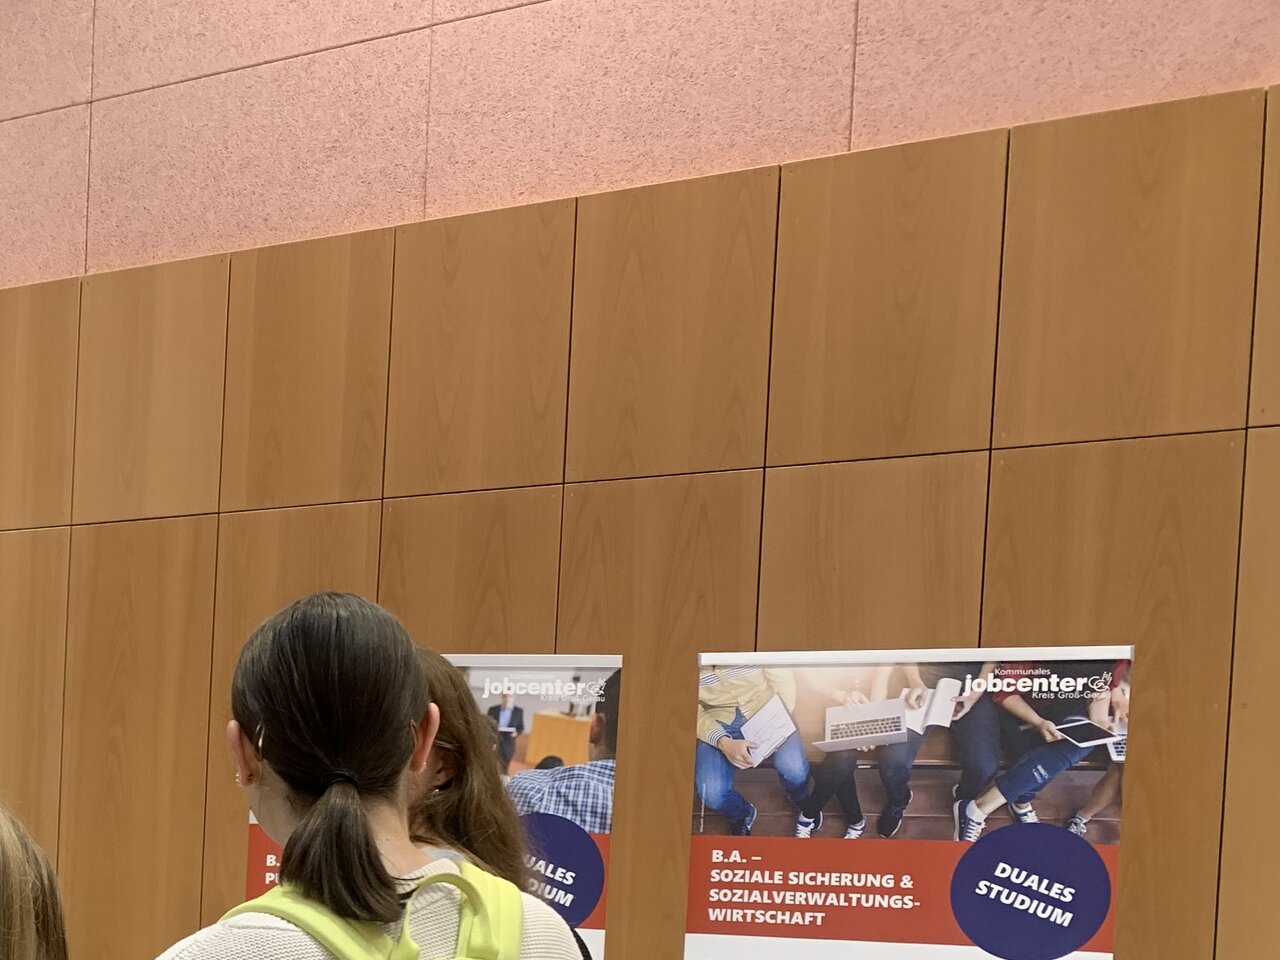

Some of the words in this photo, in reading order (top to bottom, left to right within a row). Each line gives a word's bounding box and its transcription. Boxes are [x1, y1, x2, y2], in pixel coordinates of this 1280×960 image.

[994, 668, 1051, 676] Kommunales
[482, 677, 585, 699] jobcenter
[962, 673, 1088, 697] jobcenter
[1032, 691, 1054, 699] Kreis
[711, 850, 747, 863] B.A.
[523, 854, 577, 885] UALES
[710, 869, 783, 884] SOZIALE
[788, 871, 894, 888] SICHERUNG
[899, 875, 914, 889] &
[527, 878, 575, 907] DIUM
[994, 862, 1076, 903] DUALES
[709, 889, 920, 909] SOZIALVERWALTUNGS-
[975, 880, 1073, 927] STUDIUM
[708, 908, 825, 926] WIRTSCHAFT
